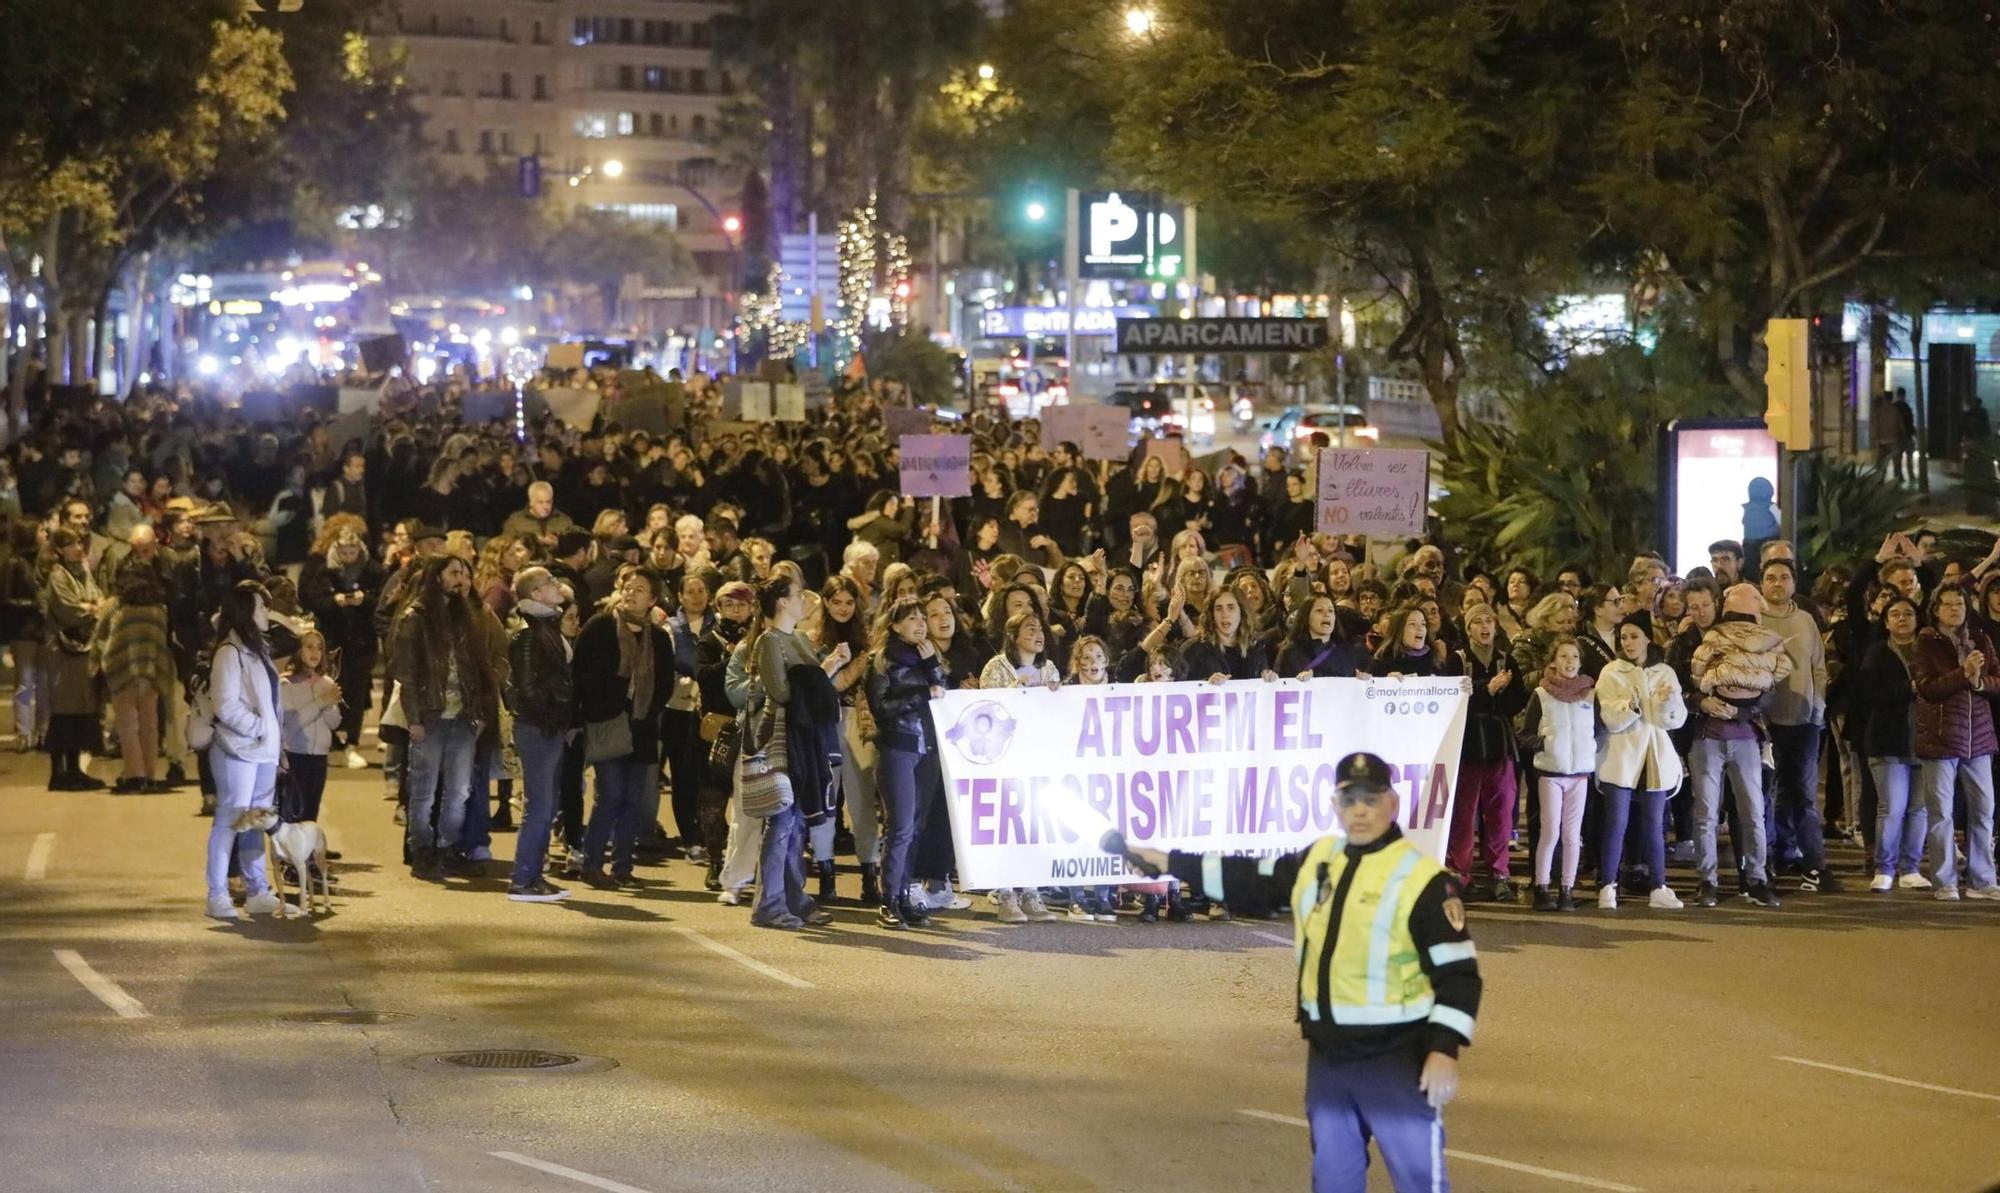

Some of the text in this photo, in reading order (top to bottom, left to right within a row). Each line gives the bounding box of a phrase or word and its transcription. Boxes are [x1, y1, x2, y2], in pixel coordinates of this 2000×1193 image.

[1124, 323, 1320, 345] APARCAMENT
[1324, 506, 1349, 524] NO
[1365, 687, 1459, 700] @movfemmallorca
[1075, 690, 1323, 758] ATUREM EL
[1226, 763, 1449, 834] MASCTA
